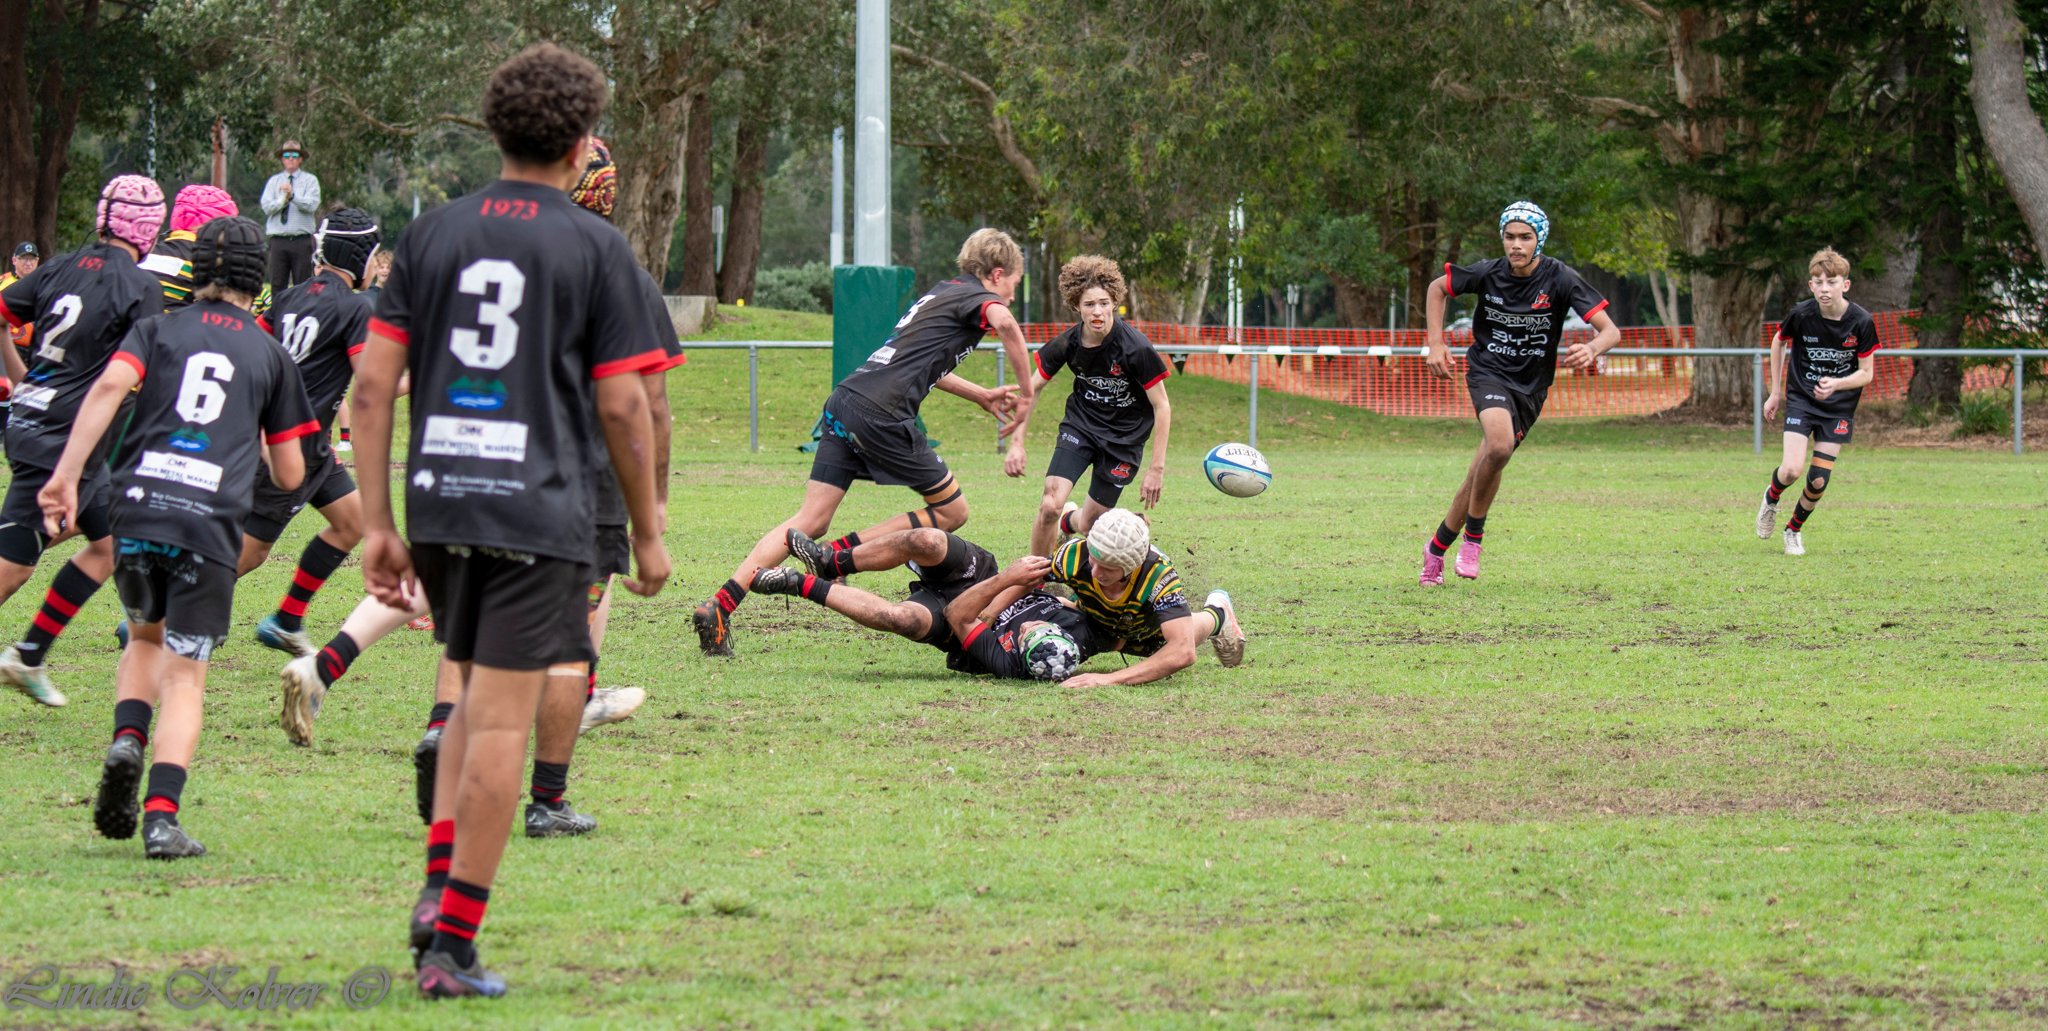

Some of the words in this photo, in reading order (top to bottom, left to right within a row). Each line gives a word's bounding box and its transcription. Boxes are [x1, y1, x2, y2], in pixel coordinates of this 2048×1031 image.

[479, 198, 540, 221] 1973
[202, 312, 243, 331] 1973
[450, 258, 527, 371] 3
[1485, 309, 1551, 326] TOORMINA
[37, 294, 83, 363] 2
[281, 313, 320, 364] 10
[1492, 328, 1548, 346] BYD
[1487, 342, 1517, 357] Coffs
[1519, 347, 1546, 358] Coas
[175, 351, 235, 425] 6
